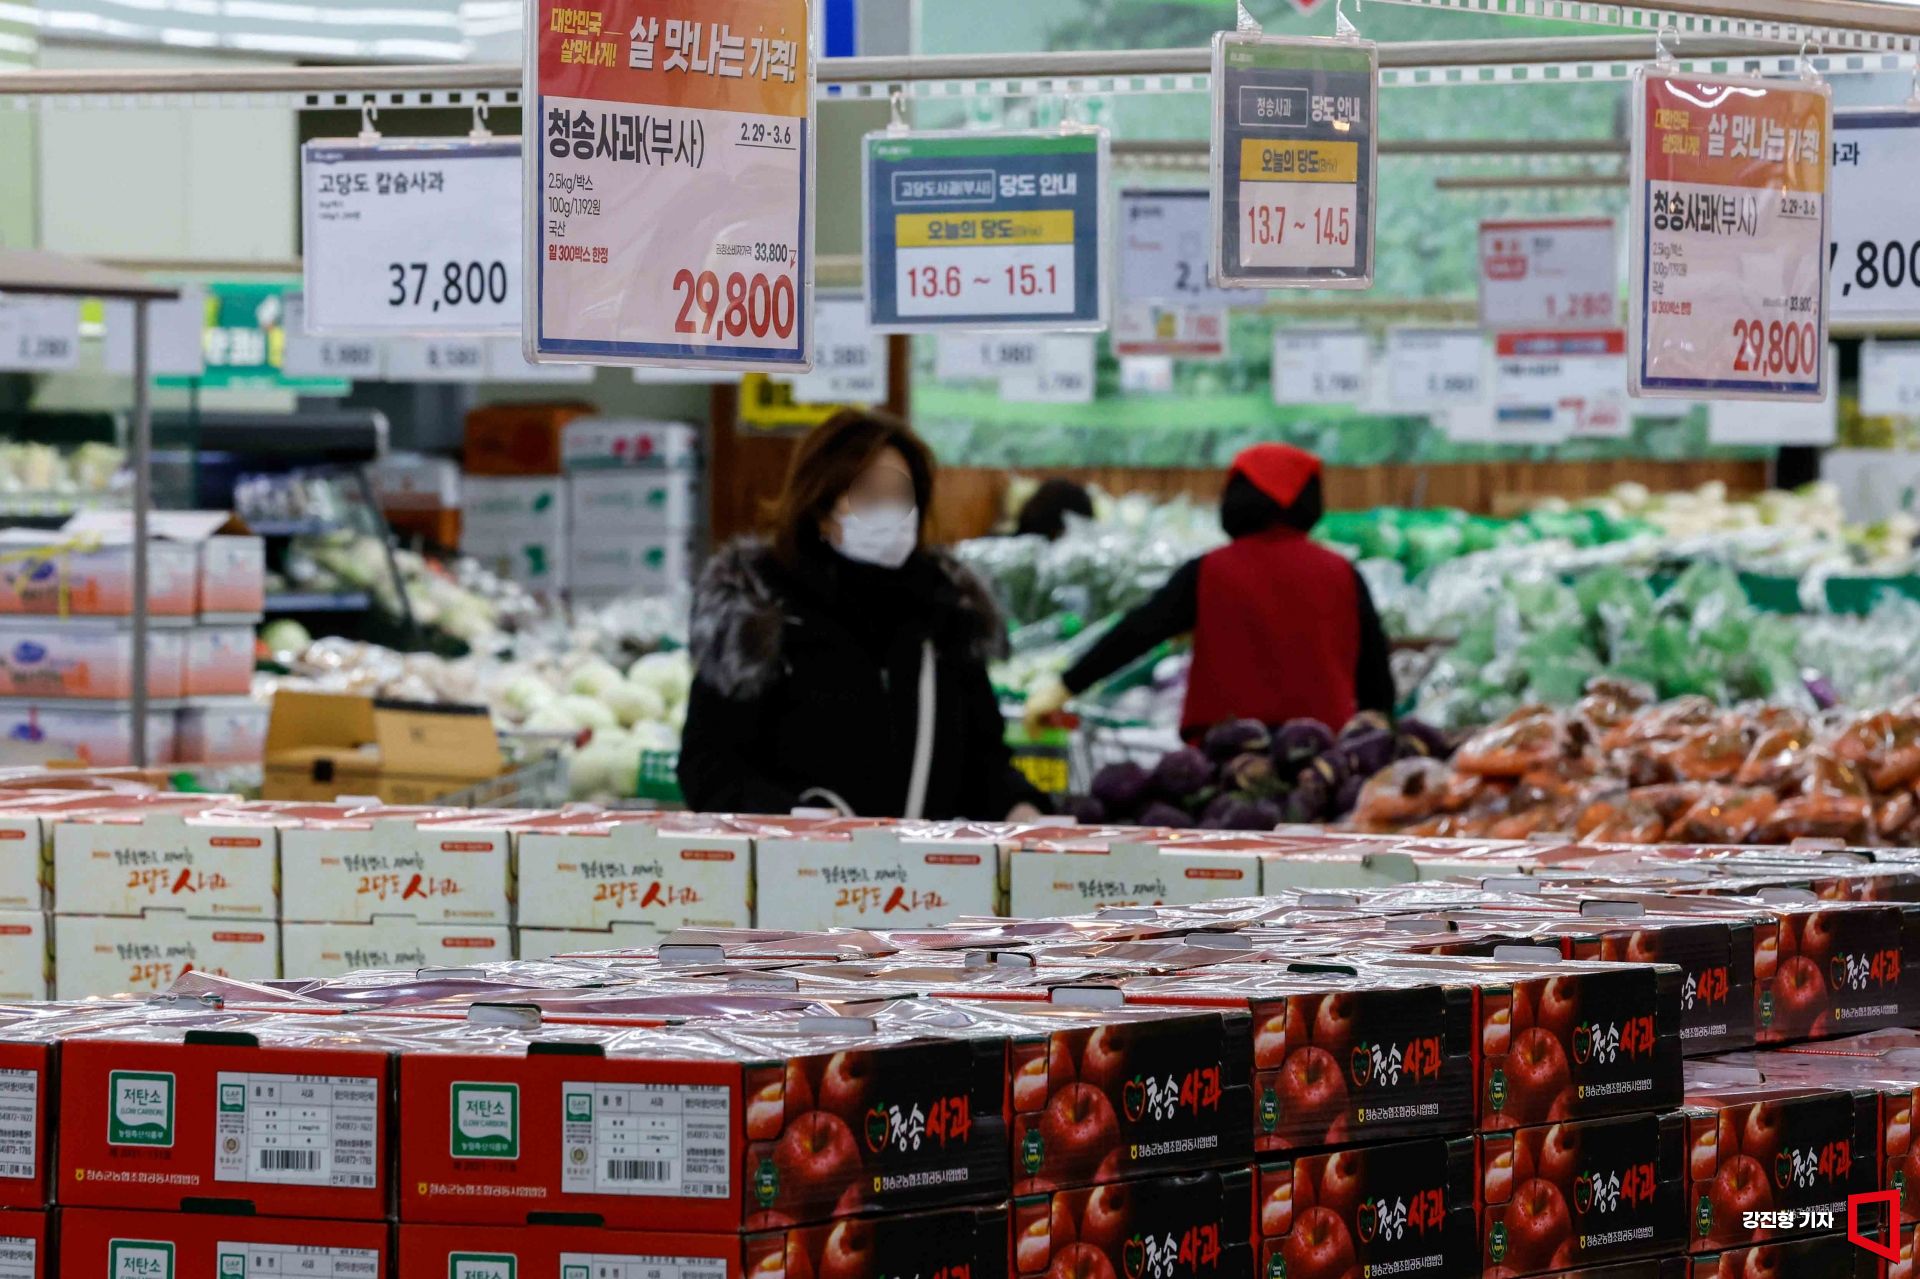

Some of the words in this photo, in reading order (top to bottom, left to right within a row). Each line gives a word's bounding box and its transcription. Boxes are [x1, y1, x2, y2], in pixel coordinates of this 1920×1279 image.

[551, 8, 602, 36] 대한민국
[560, 39, 617, 68] 살맛나게!
[629, 16, 659, 69] 살
[663, 19, 745, 78] 맛나는
[748, 38, 798, 82] 가격!
[1257, 98, 1292, 117] 청송사과
[1312, 96, 1335, 122] 당도
[1337, 96, 1361, 123] 안내
[548, 108, 704, 168] 청송사과(부사)
[1708, 114, 1728, 157] 살
[1730, 115, 1785, 161] 맛나는
[1261, 148, 1294, 174] 오늘의
[319, 174, 370, 196] 고당도
[376, 171, 444, 195] 칼슘사과
[1000, 174, 1036, 197] 당도
[1039, 173, 1077, 196] 안내
[1248, 206, 1286, 245] 13.7
[1314, 207, 1349, 245] 14.5
[1654, 189, 1758, 236] 청송사과(부사)
[549, 221, 566, 237] 국산
[928, 220, 977, 240] 오늘의
[549, 244, 557, 260] 일
[559, 245, 590, 262] 300박스
[593, 247, 609, 263] 한정
[754, 242, 788, 263] 33,800
[389, 261, 507, 312] 37,800
[908, 265, 961, 297] 13.6
[1005, 264, 1056, 295] 15.1
[673, 268, 795, 341] 29,800
[1733, 318, 1816, 376] 29,800
[124, 1088, 162, 1106] 저탄소
[466, 1100, 505, 1118] 저탄소
[124, 1256, 161, 1275] 저탄소
